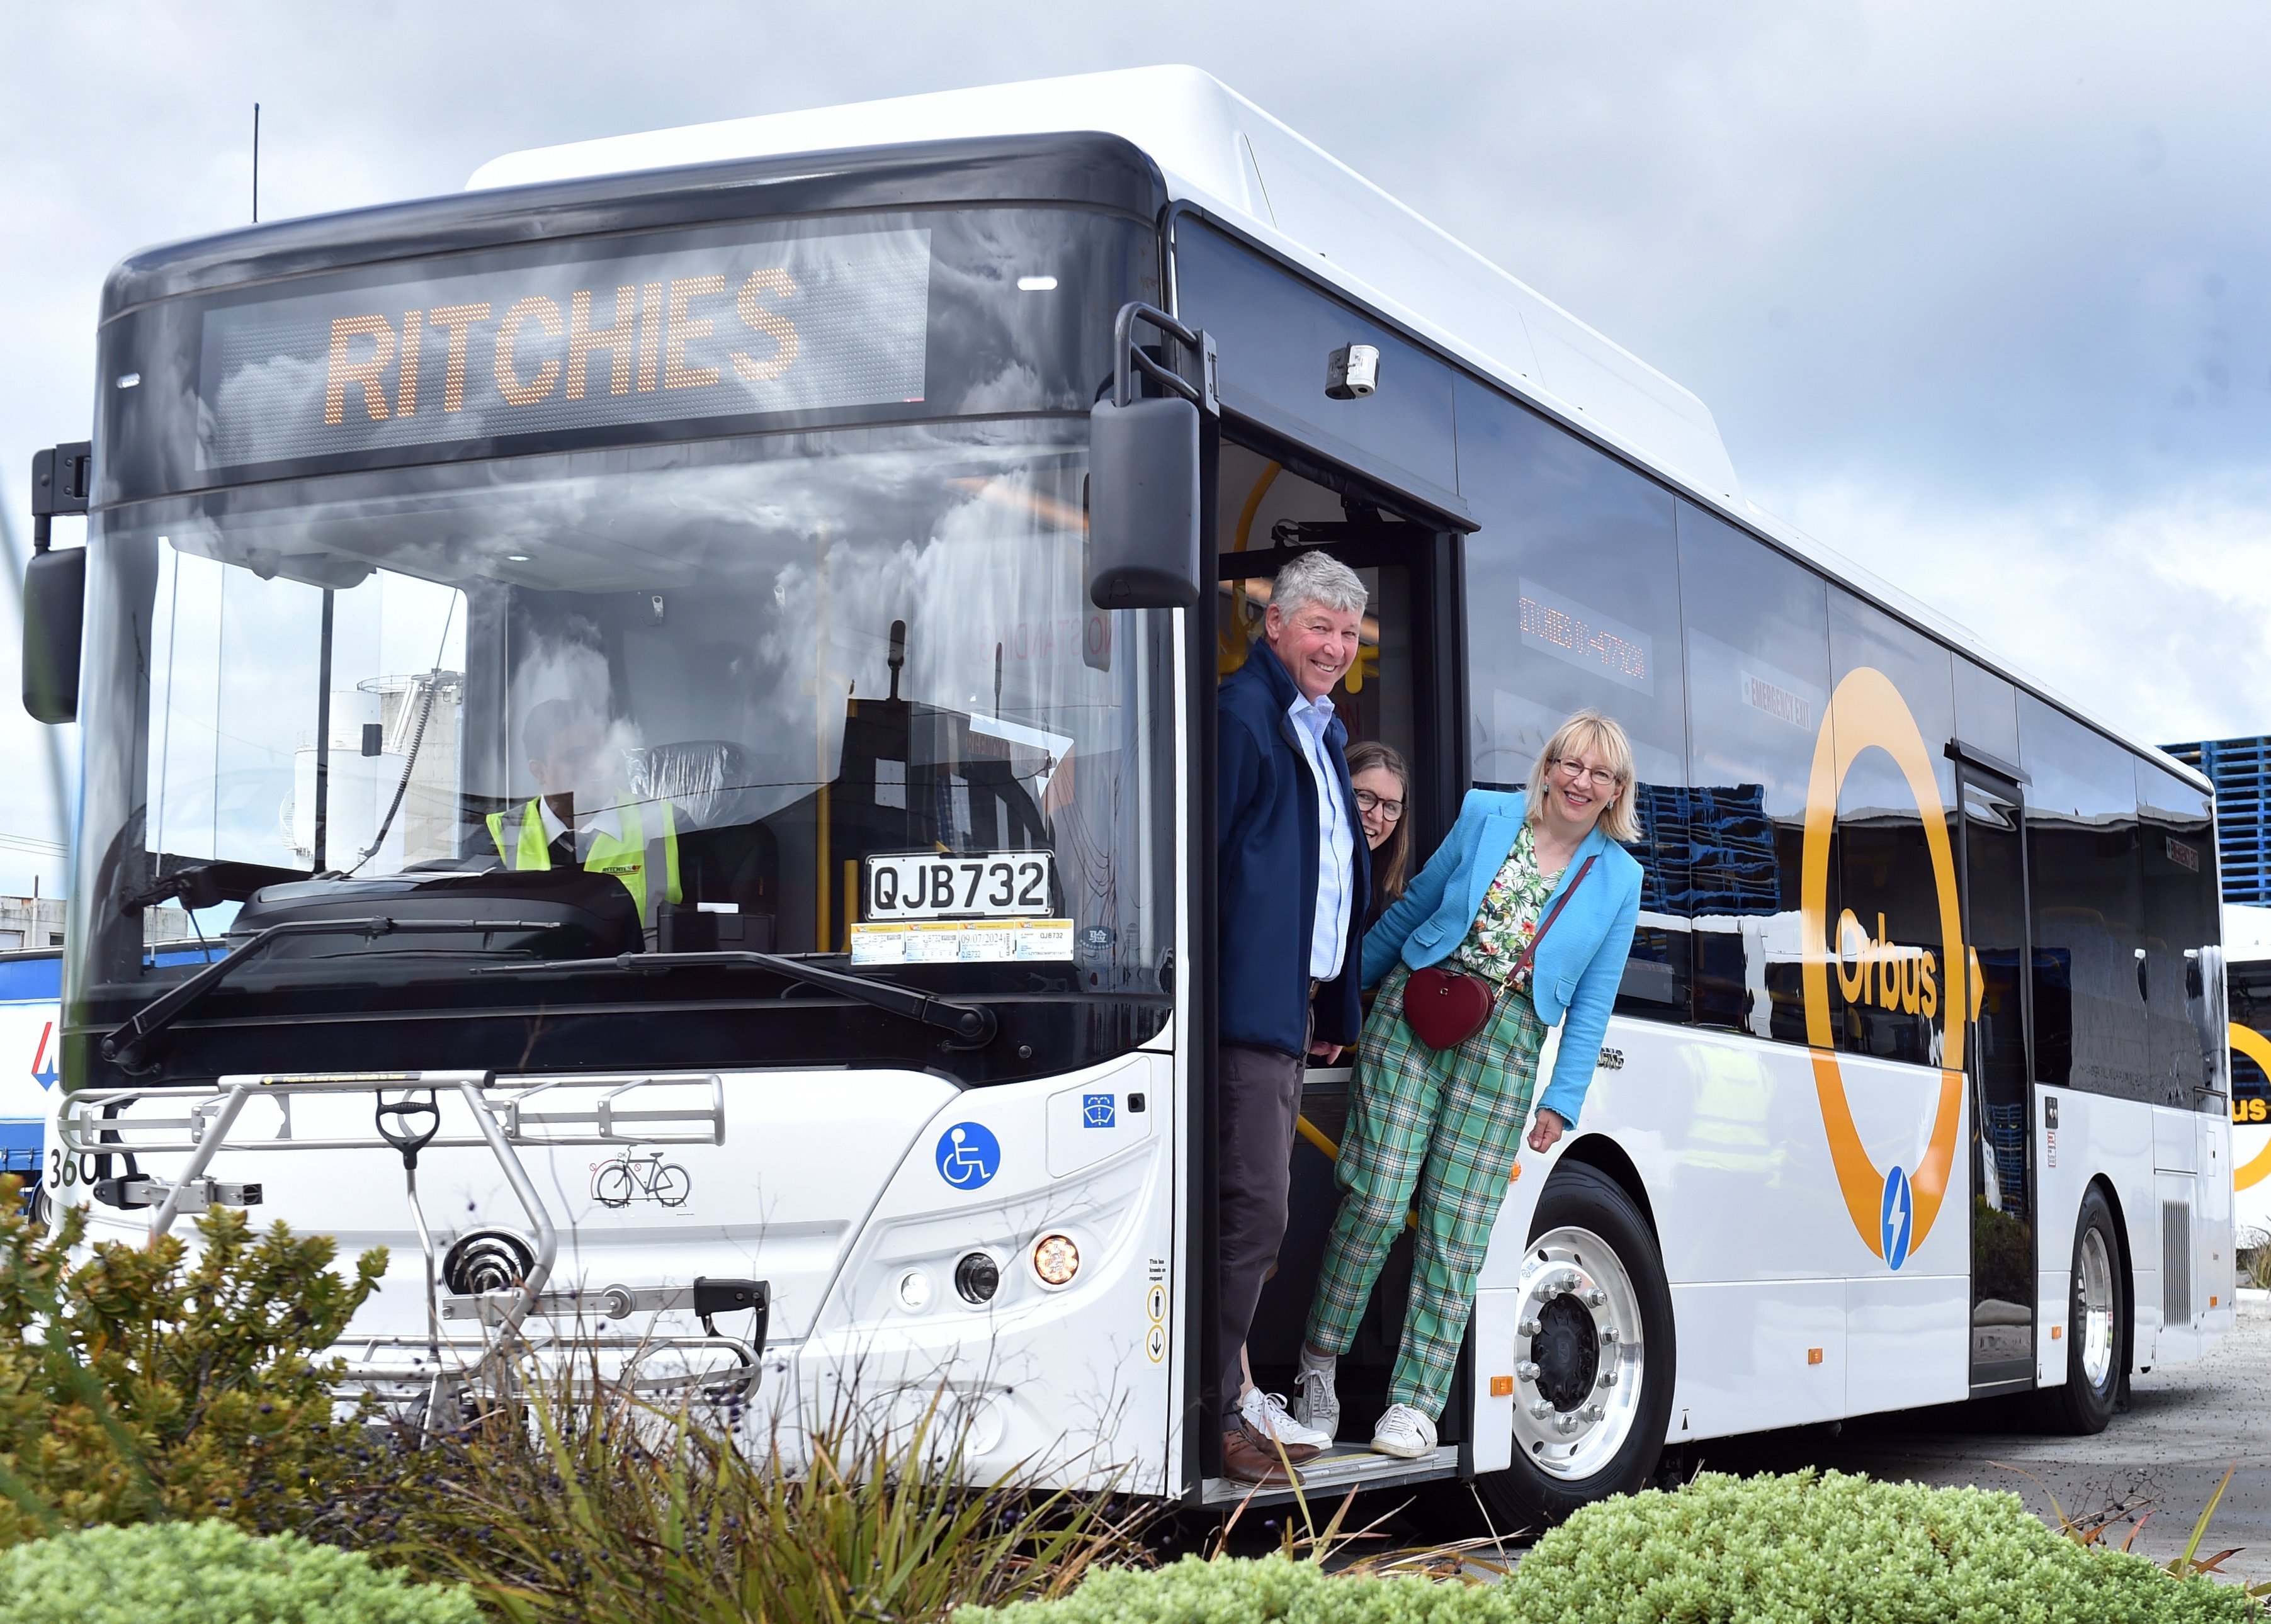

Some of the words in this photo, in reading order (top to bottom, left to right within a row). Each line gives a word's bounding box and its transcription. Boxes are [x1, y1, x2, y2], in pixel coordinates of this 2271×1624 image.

[324, 269, 800, 426] RITCHIES
[1750, 677, 1794, 723] EMERGENCY
[1794, 697, 1809, 729] EXIT
[874, 861, 1045, 910] QJB732
[961, 933, 1003, 945] 09/07/2024
[1089, 930, 1107, 943] 验
[1835, 908, 1937, 1018] Orbus
